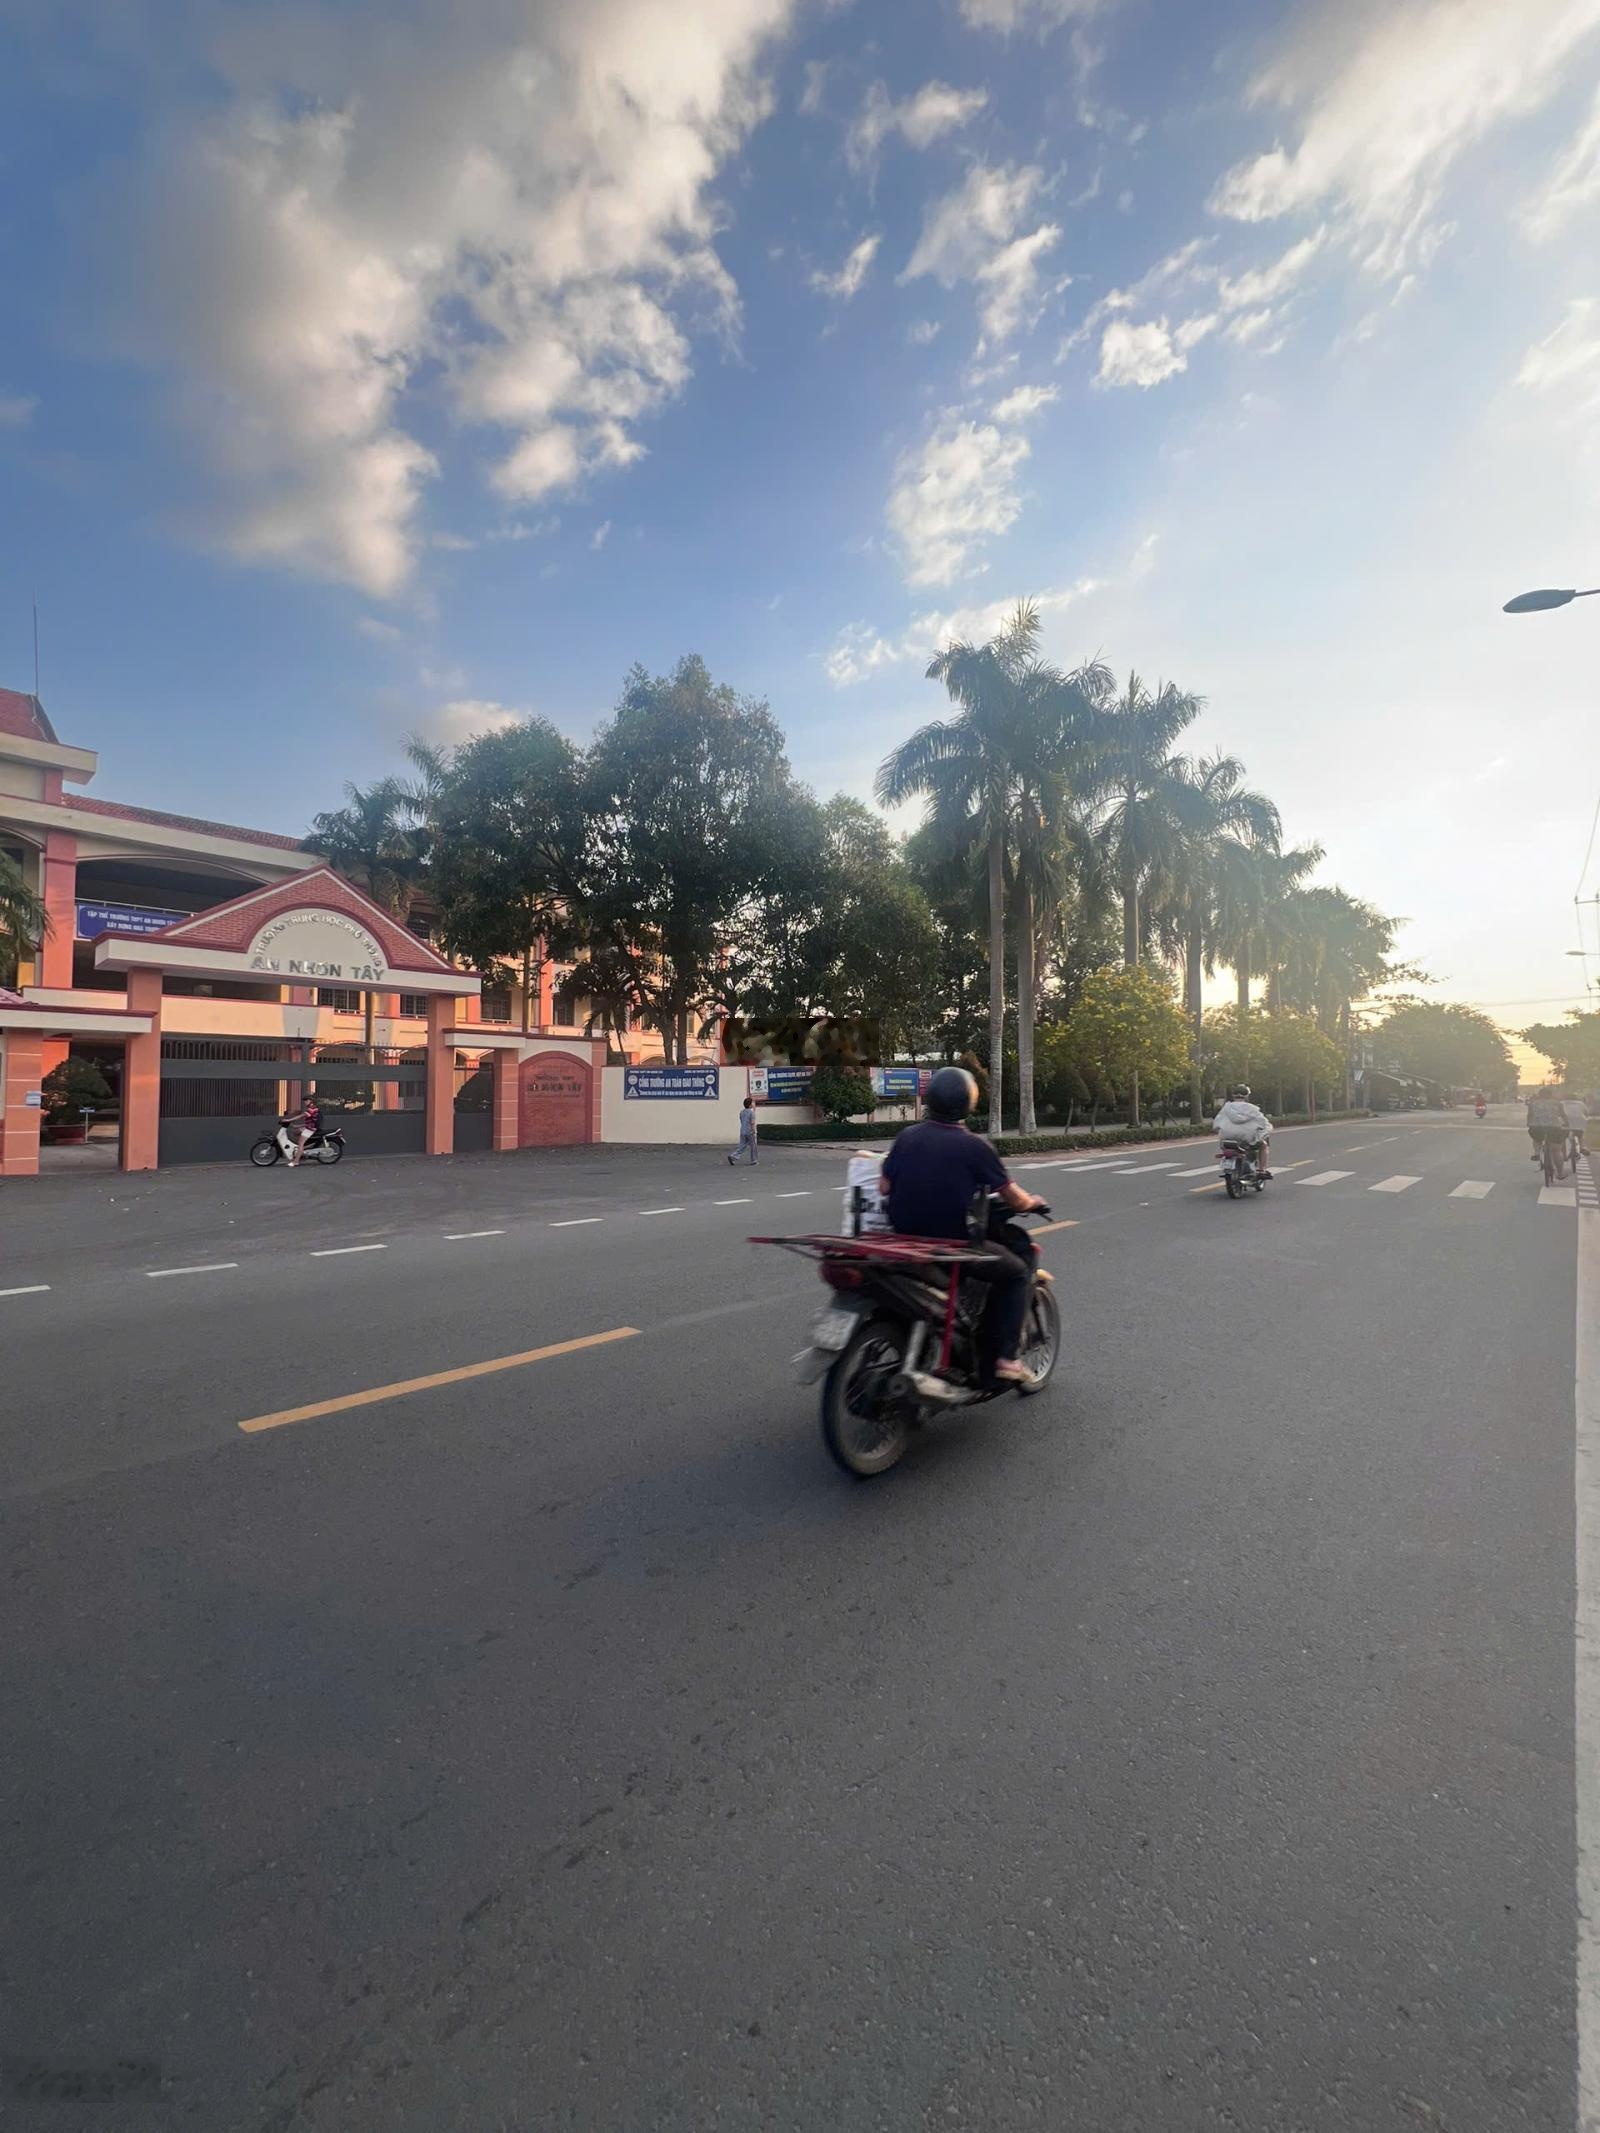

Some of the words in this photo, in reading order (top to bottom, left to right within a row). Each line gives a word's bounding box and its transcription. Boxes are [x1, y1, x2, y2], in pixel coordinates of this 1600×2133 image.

[251, 956, 280, 971] AN
[289, 959, 342, 977] NHƠN
[350, 964, 385, 981] TÂY
